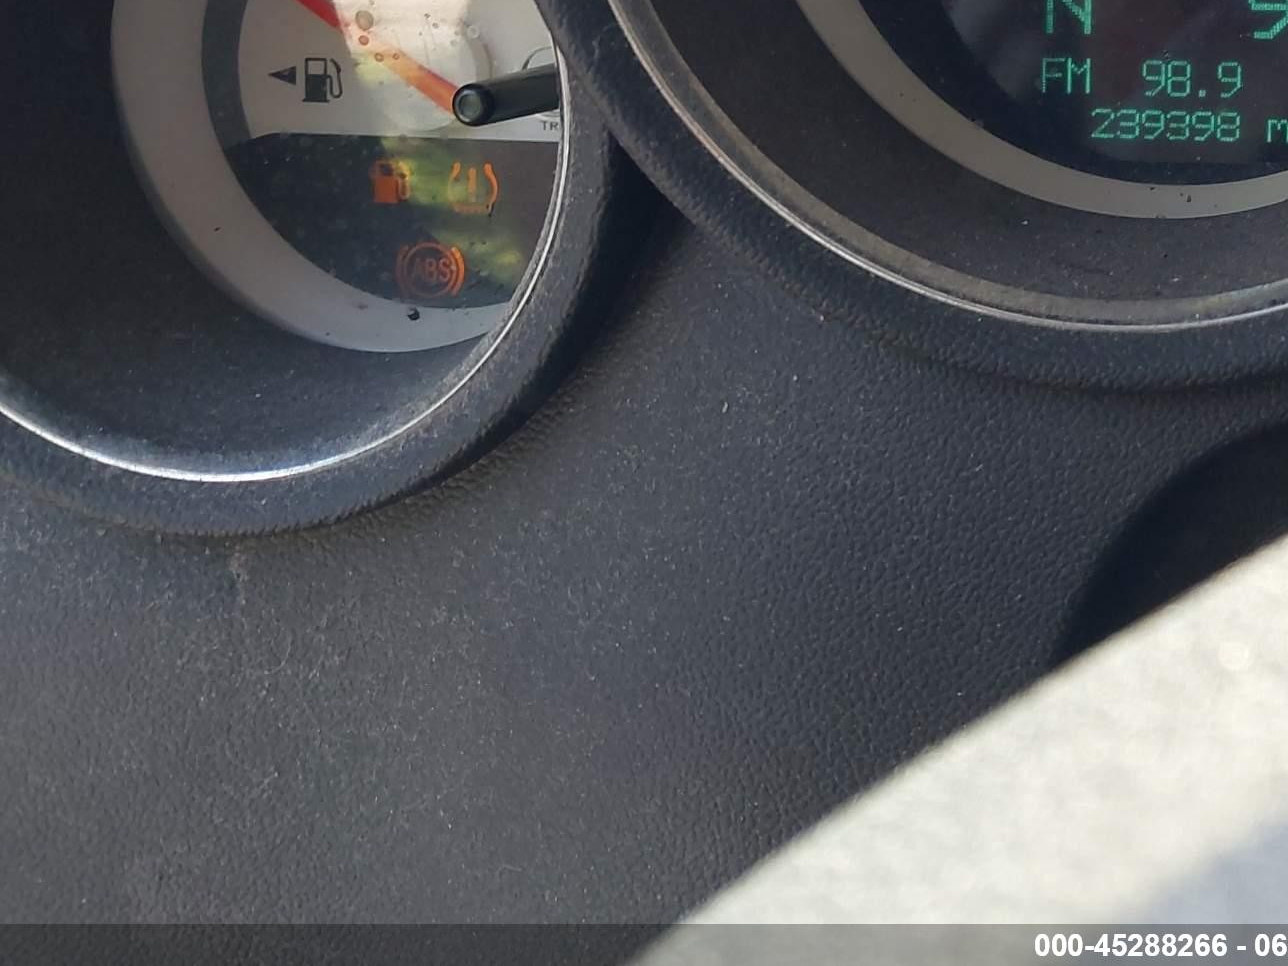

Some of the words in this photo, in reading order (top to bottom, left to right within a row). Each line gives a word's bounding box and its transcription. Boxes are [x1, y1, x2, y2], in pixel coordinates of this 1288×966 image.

[1041, 57, 1091, 94] FM
[1142, 59, 1243, 98] 98.9
[1091, 108, 1241, 143] 239398
[413, 257, 451, 283] ABS
